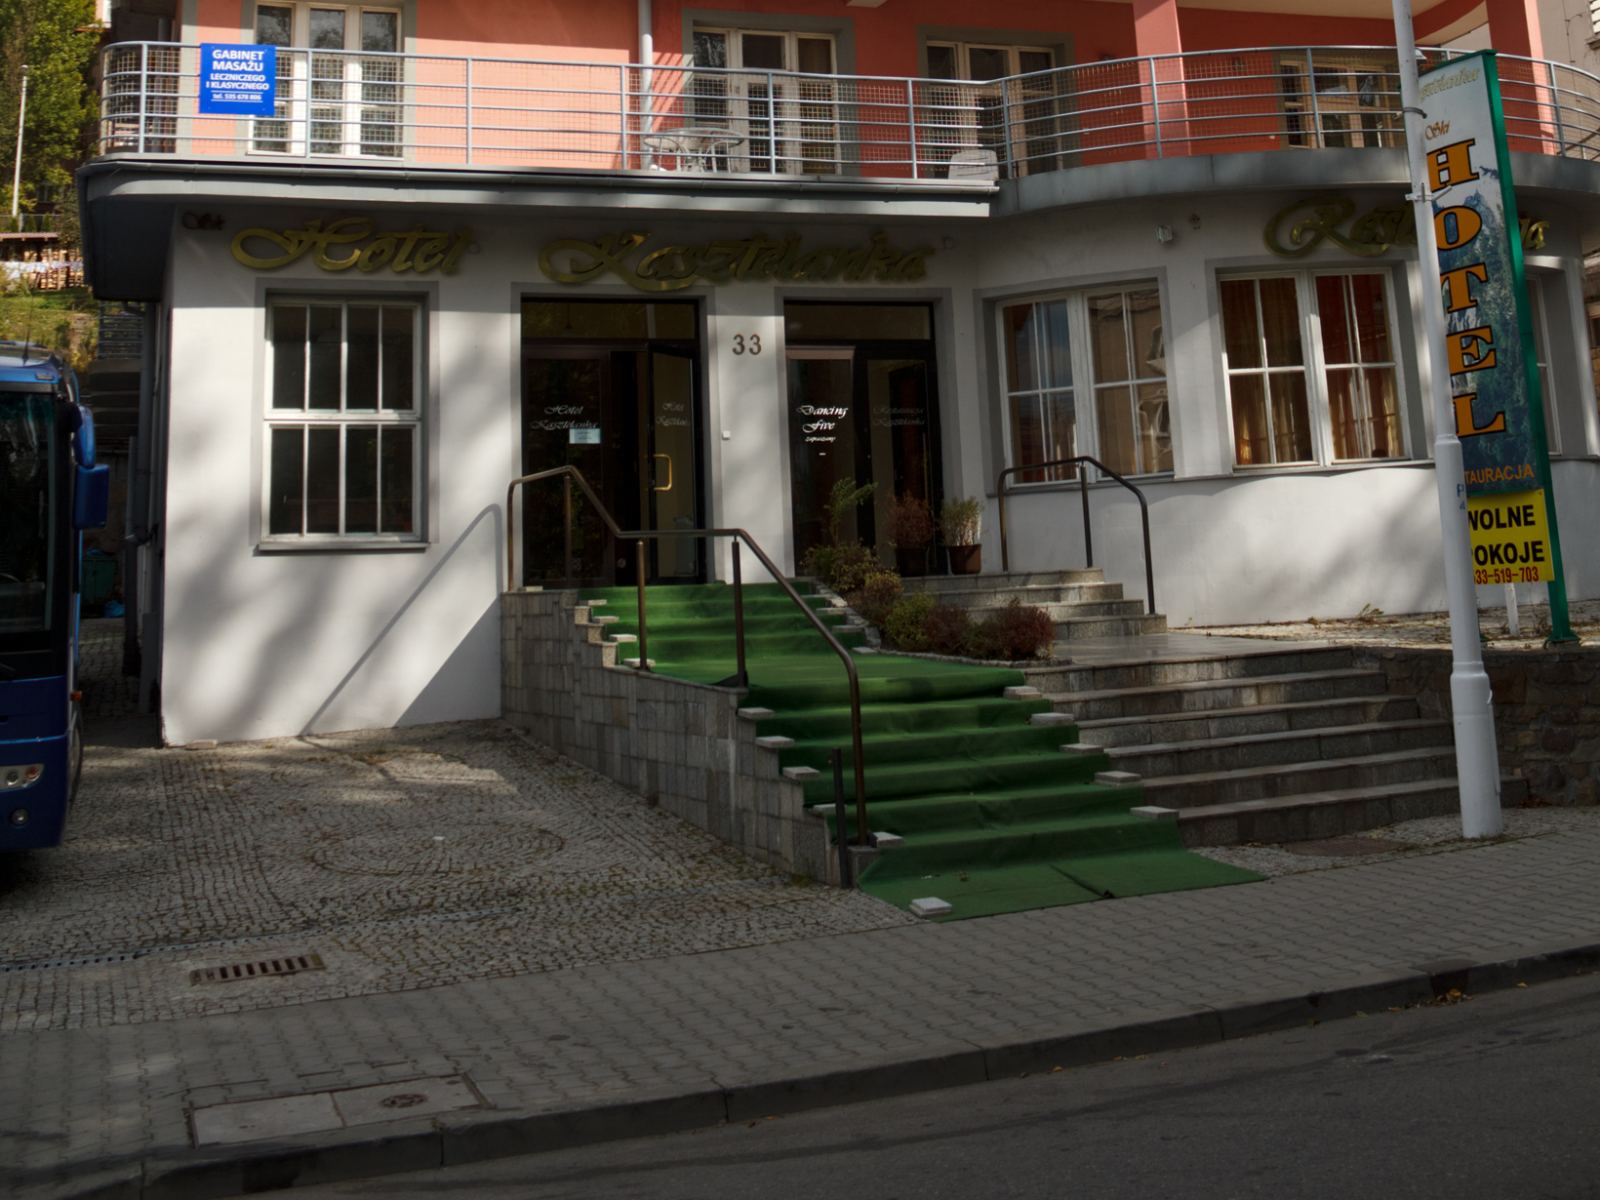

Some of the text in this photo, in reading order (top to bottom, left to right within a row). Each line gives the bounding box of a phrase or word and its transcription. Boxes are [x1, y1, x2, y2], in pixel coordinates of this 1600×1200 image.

[212, 49, 264, 60] GABINET
[212, 61, 264, 71] MASAŻU
[210, 73, 266, 82] LECZNICZEGO
[211, 81, 270, 90] KLASYCZNEGO
[230, 215, 941, 293] Hotel Kasztelanka
[1426, 138, 1506, 438] HOTEL
[732, 333, 762, 356] 33
[544, 403, 585, 415] Hotel
[798, 404, 849, 420] Dancing
[802, 419, 836, 434] Five
[1464, 464, 1535, 485] TAURACJA
[1471, 540, 1545, 566] OKOJE
[1473, 566, 1539, 585] 33-519-703
